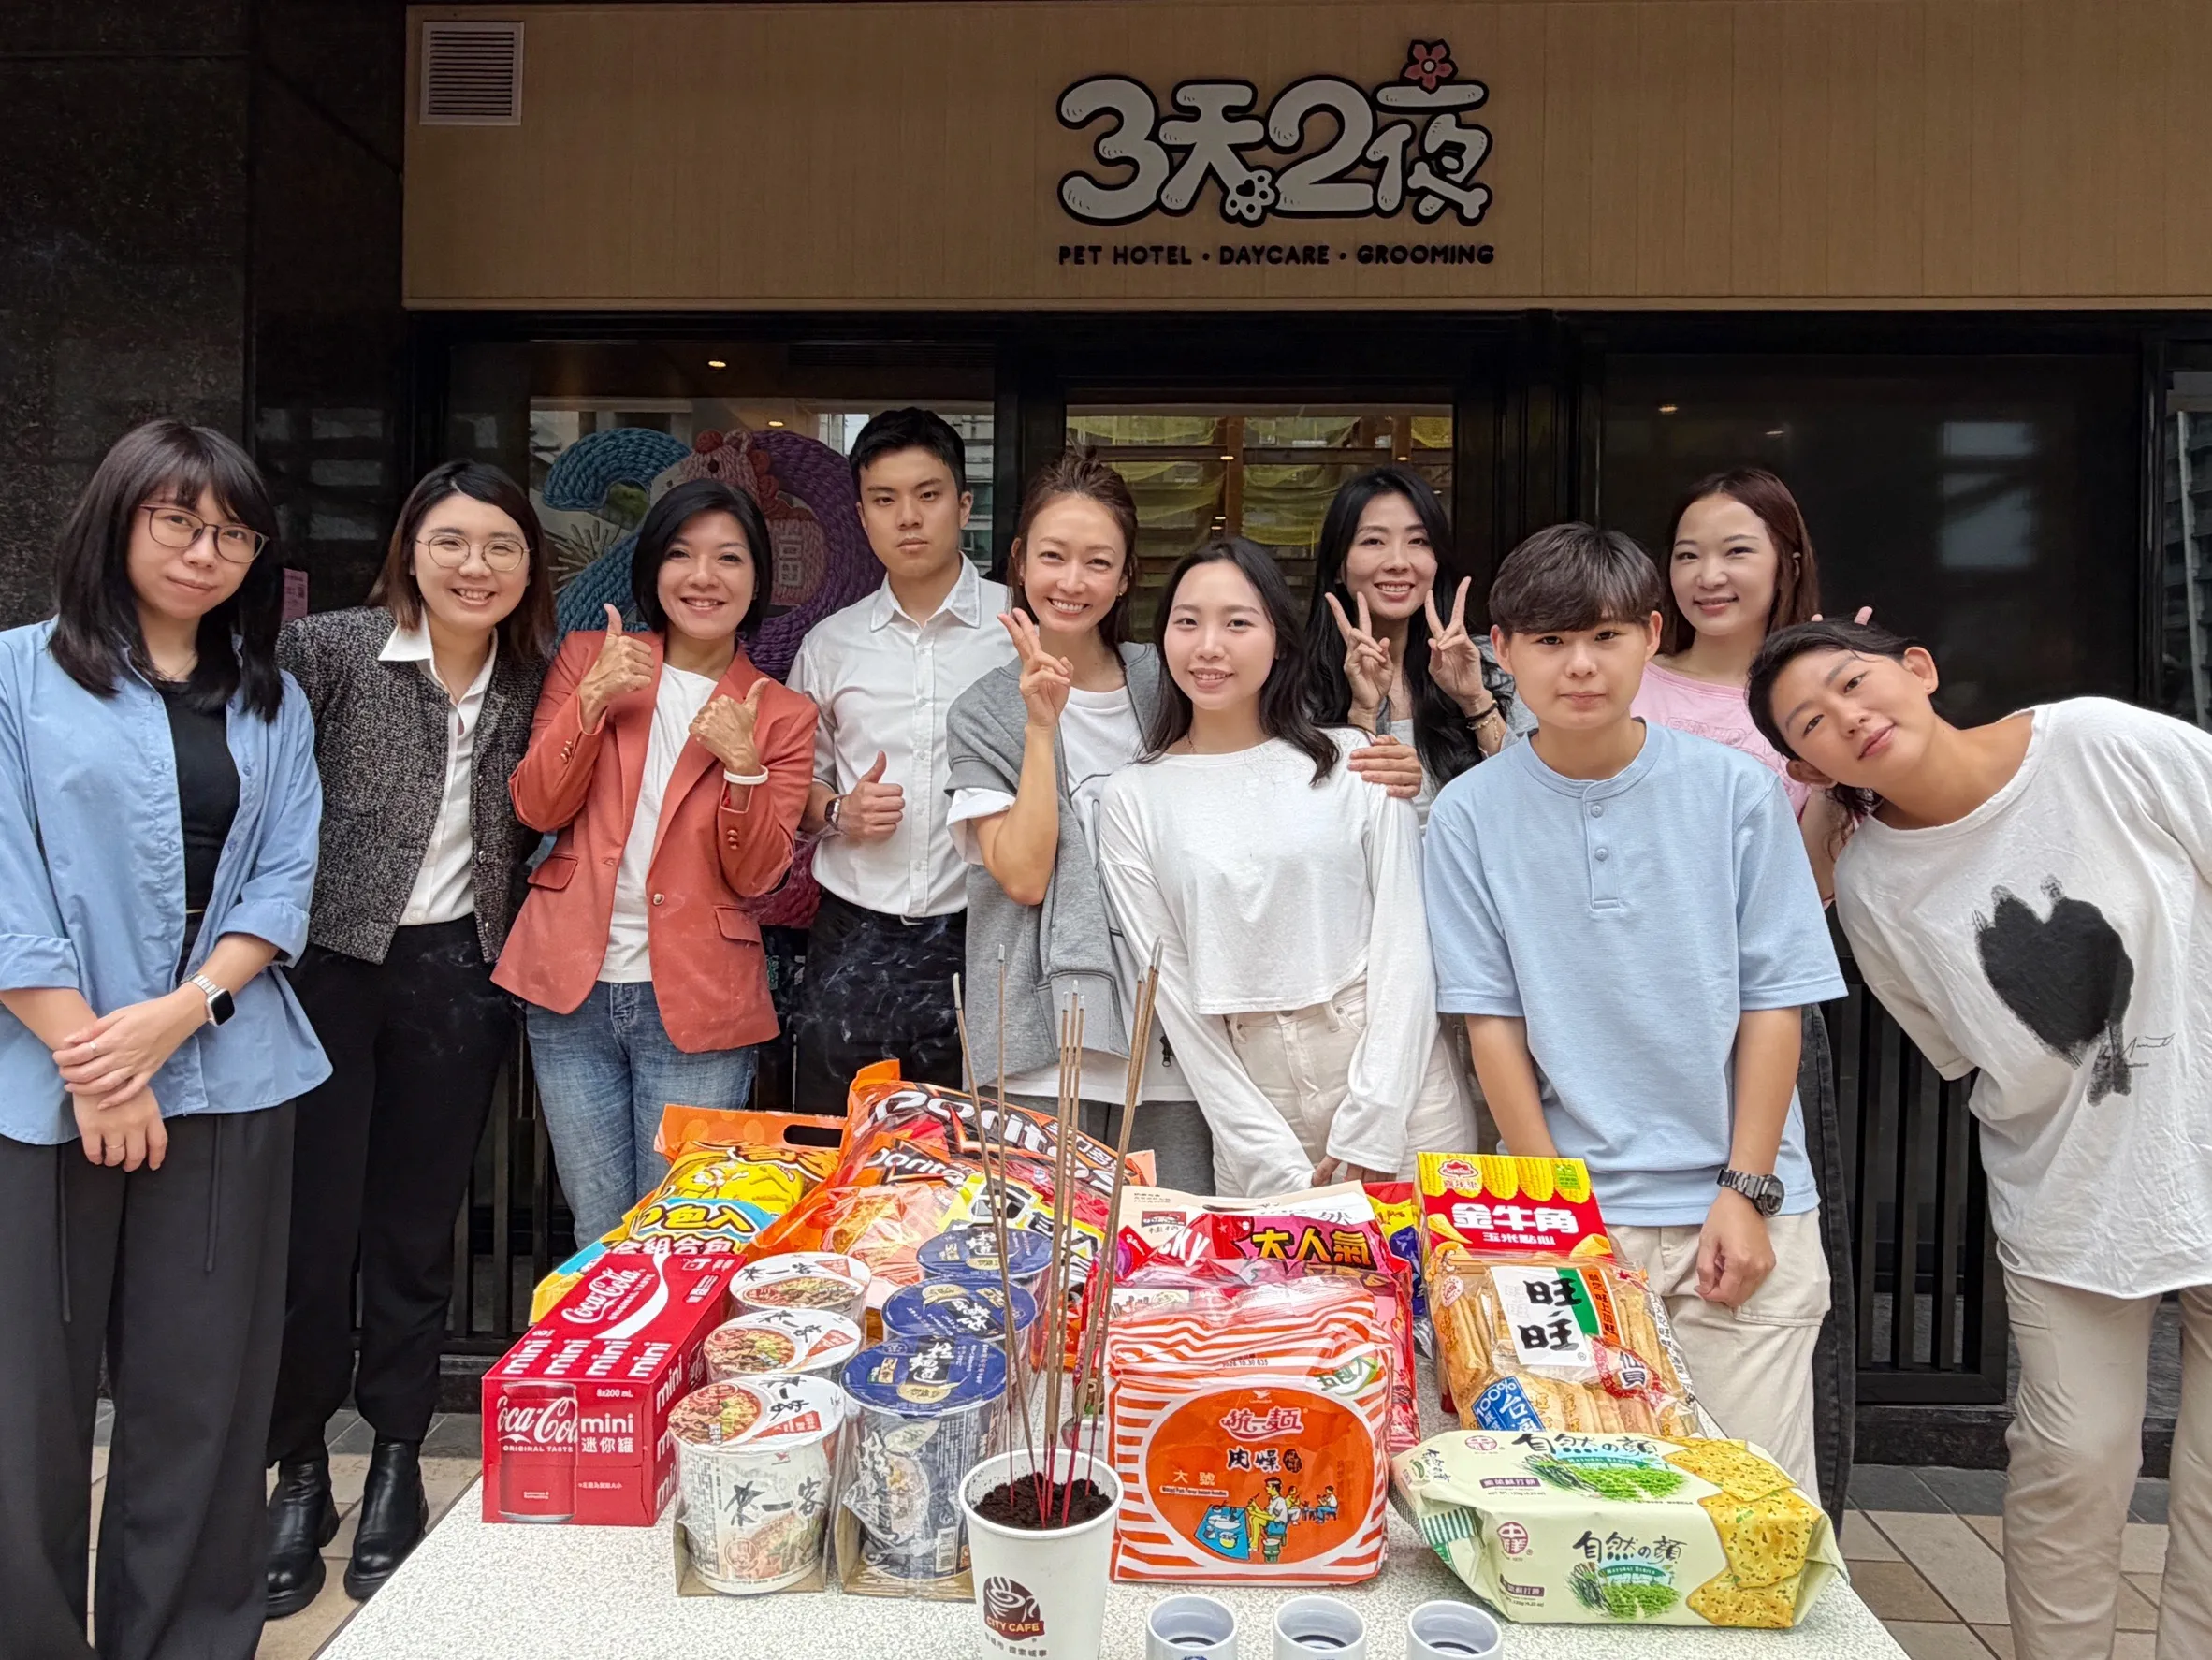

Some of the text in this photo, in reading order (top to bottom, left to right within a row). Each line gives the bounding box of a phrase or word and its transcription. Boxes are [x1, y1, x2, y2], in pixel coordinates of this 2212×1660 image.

[1057, 74, 1492, 226] 3天2夜
[1058, 243, 1494, 266] PET HOTEL DAYCARE GROOMING
[1450, 1202, 1579, 1234] 金牛角
[1251, 1227, 1372, 1265] 大人氣
[1481, 1231, 1556, 1245] 玉米點心
[560, 1266, 642, 1324] Coca-Cola
[502, 1338, 553, 1375] mini
[543, 1338, 592, 1376] mini
[584, 1339, 633, 1376] mini
[627, 1341, 673, 1377] mini
[656, 1353, 684, 1414] mini
[1475, 1377, 1518, 1418] 100%
[580, 1412, 634, 1433] mini
[1221, 1407, 1303, 1439] 統一麵
[546, 1445, 574, 1453] TASTE
[581, 1436, 634, 1454] 迷你罐
[1173, 1469, 1215, 1486] 大號
[986, 1615, 1040, 1633] CITY CAFE
